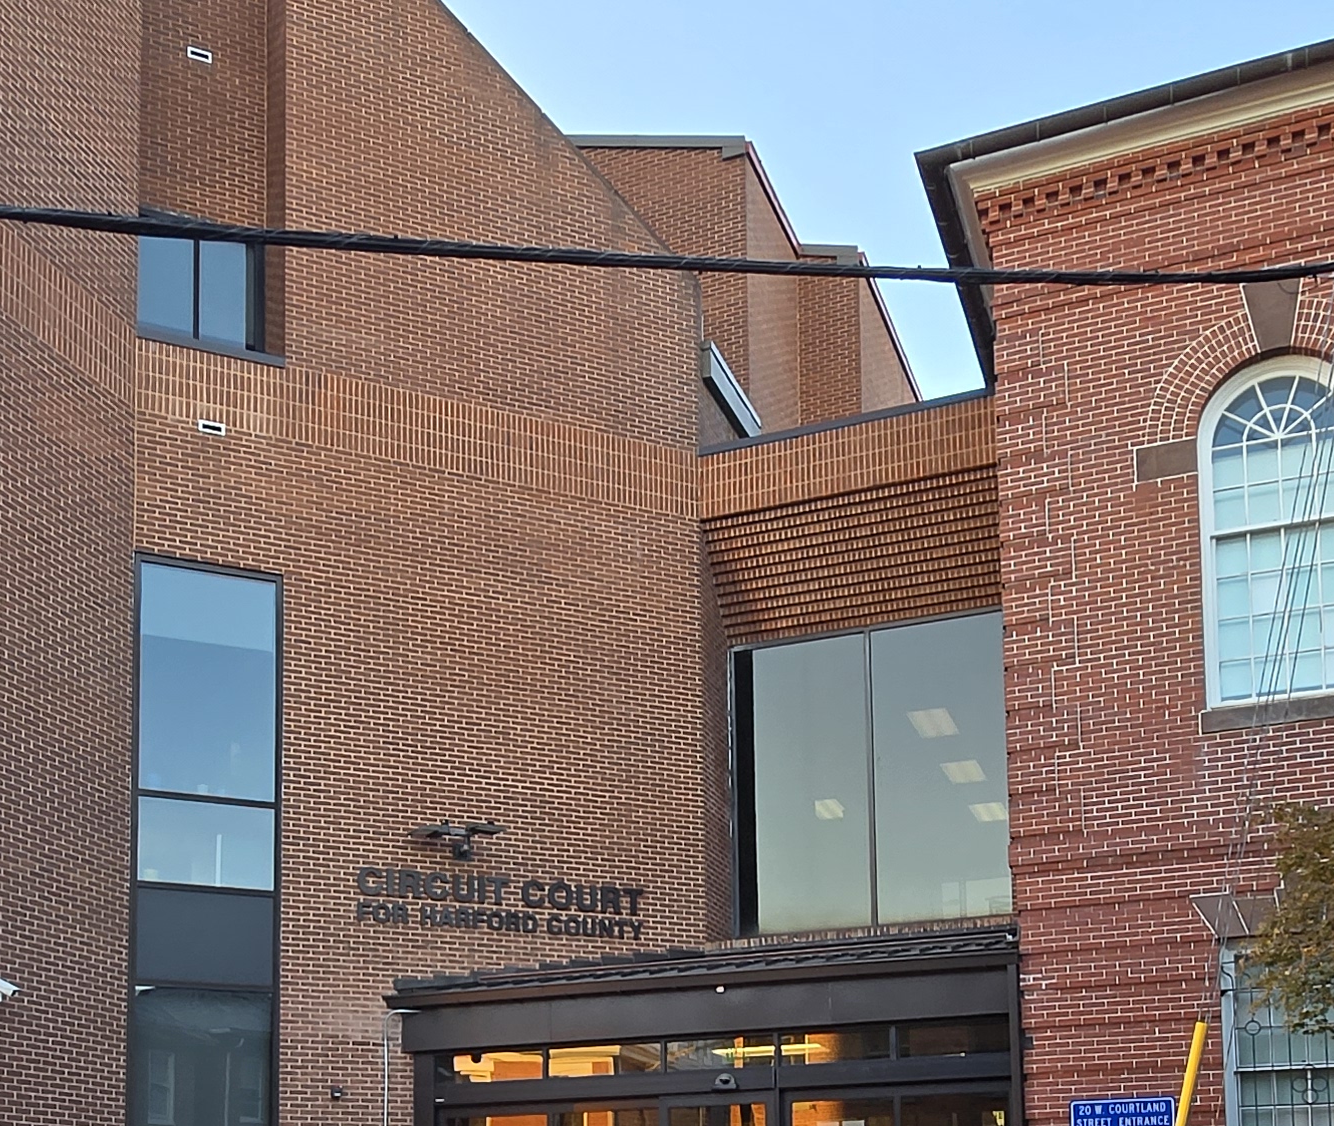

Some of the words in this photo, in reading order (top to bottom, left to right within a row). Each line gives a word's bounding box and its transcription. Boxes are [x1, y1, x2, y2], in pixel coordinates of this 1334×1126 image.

[357, 867, 509, 906] CIRCUIT
[521, 880, 644, 917] COURT
[357, 902, 409, 925] FOR
[421, 906, 538, 933] HARFORD
[547, 916, 643, 940] COUNTY
[1079, 1105, 1091, 1116] 20
[1095, 1105, 1105, 1115] W.
[1109, 1102, 1166, 1114] COURTLAND
